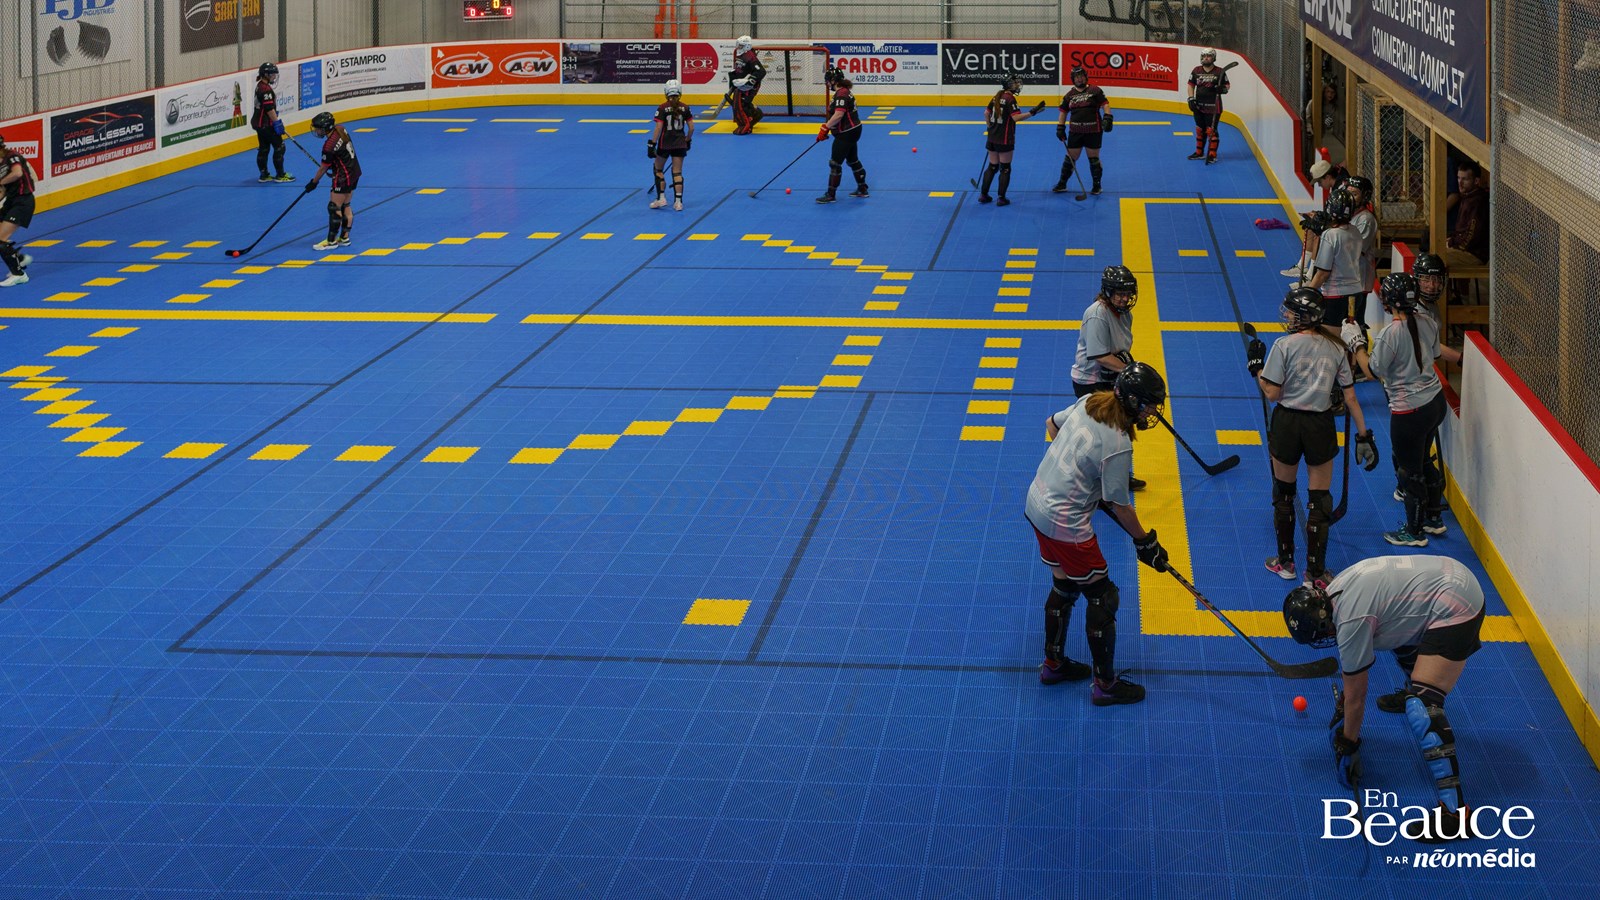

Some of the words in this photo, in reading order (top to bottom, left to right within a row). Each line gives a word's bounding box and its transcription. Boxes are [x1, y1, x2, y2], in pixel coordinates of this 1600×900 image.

[83, 8, 115, 16] INDUSTRIES
[1400, 0, 1455, 46] D'AFFICHAGE
[340, 54, 386, 68] ESTAMPRO
[508, 61, 553, 72] A&W
[837, 58, 897, 73] FALRO
[946, 48, 1056, 70] Venture
[1071, 51, 1136, 69] SCOOP
[1139, 54, 1172, 72] Vision
[1372, 26, 1418, 81] COMMERCIAL
[1419, 51, 1464, 108] COMPLET
[444, 62, 488, 76] A&W
[178, 96, 205, 110] Francis
[204, 91, 229, 107] Carrier
[64, 128, 94, 140] GARAGE
[64, 134, 99, 150] DANIEL
[99, 123, 144, 140] LESSARD
[9, 146, 36, 155] AISON
[55, 166, 62, 174] LE
[62, 161, 76, 172] PLUS
[77, 157, 96, 168] GRAND
[96, 150, 125, 164] INVENTAIRE
[125, 148, 133, 157] EN
[133, 142, 154, 154] BEAUCE!
